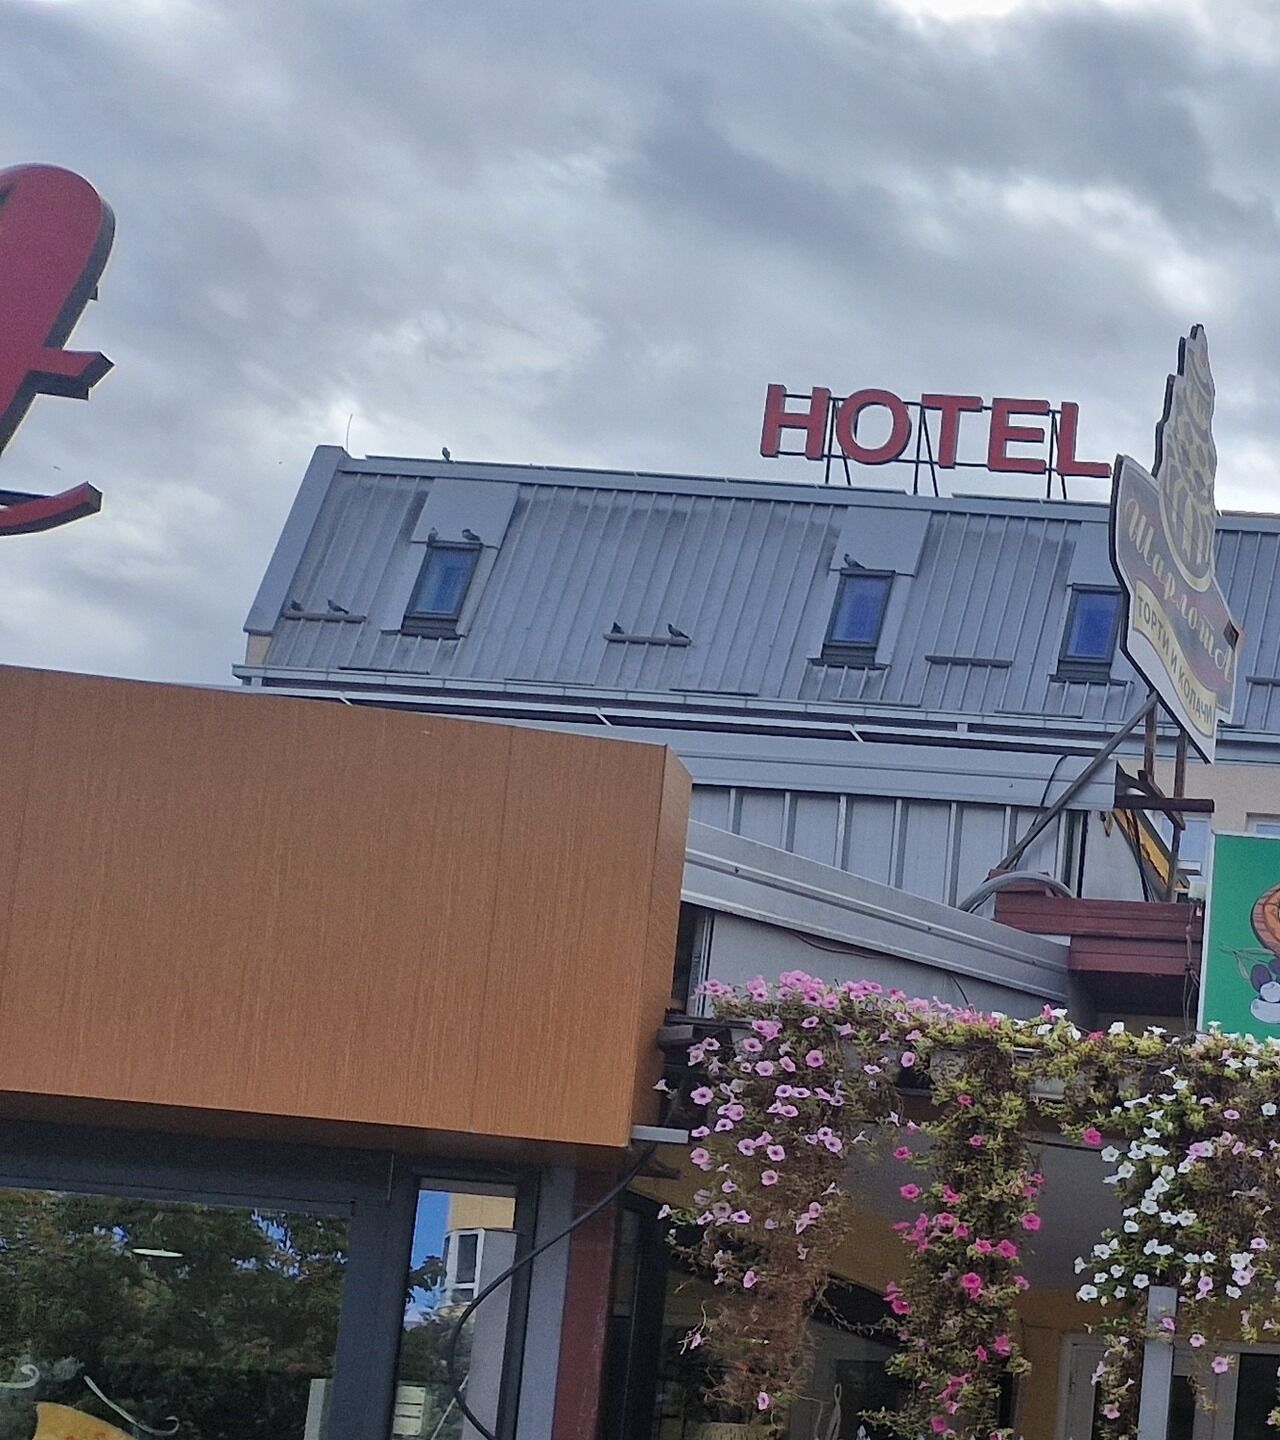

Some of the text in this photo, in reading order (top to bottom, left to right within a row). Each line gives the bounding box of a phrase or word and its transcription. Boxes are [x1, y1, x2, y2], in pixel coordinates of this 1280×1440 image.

[760, 383, 1112, 478] HOTEL
[1137, 594, 1170, 657] ТОРТИ
[1178, 665, 1213, 725] КОЛАЧИ
